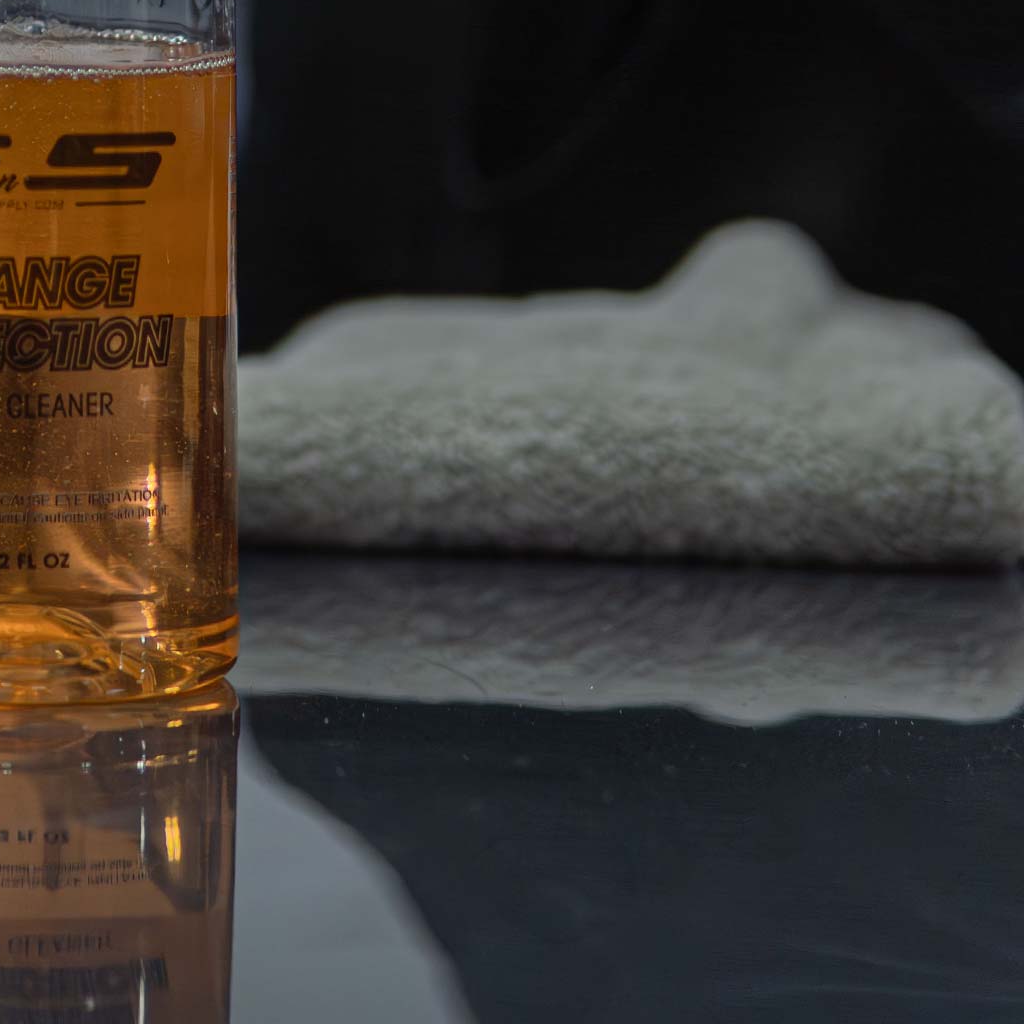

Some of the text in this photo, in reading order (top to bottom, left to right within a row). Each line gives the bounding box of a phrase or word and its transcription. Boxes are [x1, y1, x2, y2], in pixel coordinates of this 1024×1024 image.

[6, 391, 114, 419] CLEANER
[55, 492, 83, 506] EYE
[17, 552, 36, 570] FL
[43, 552, 70, 569] OZ
